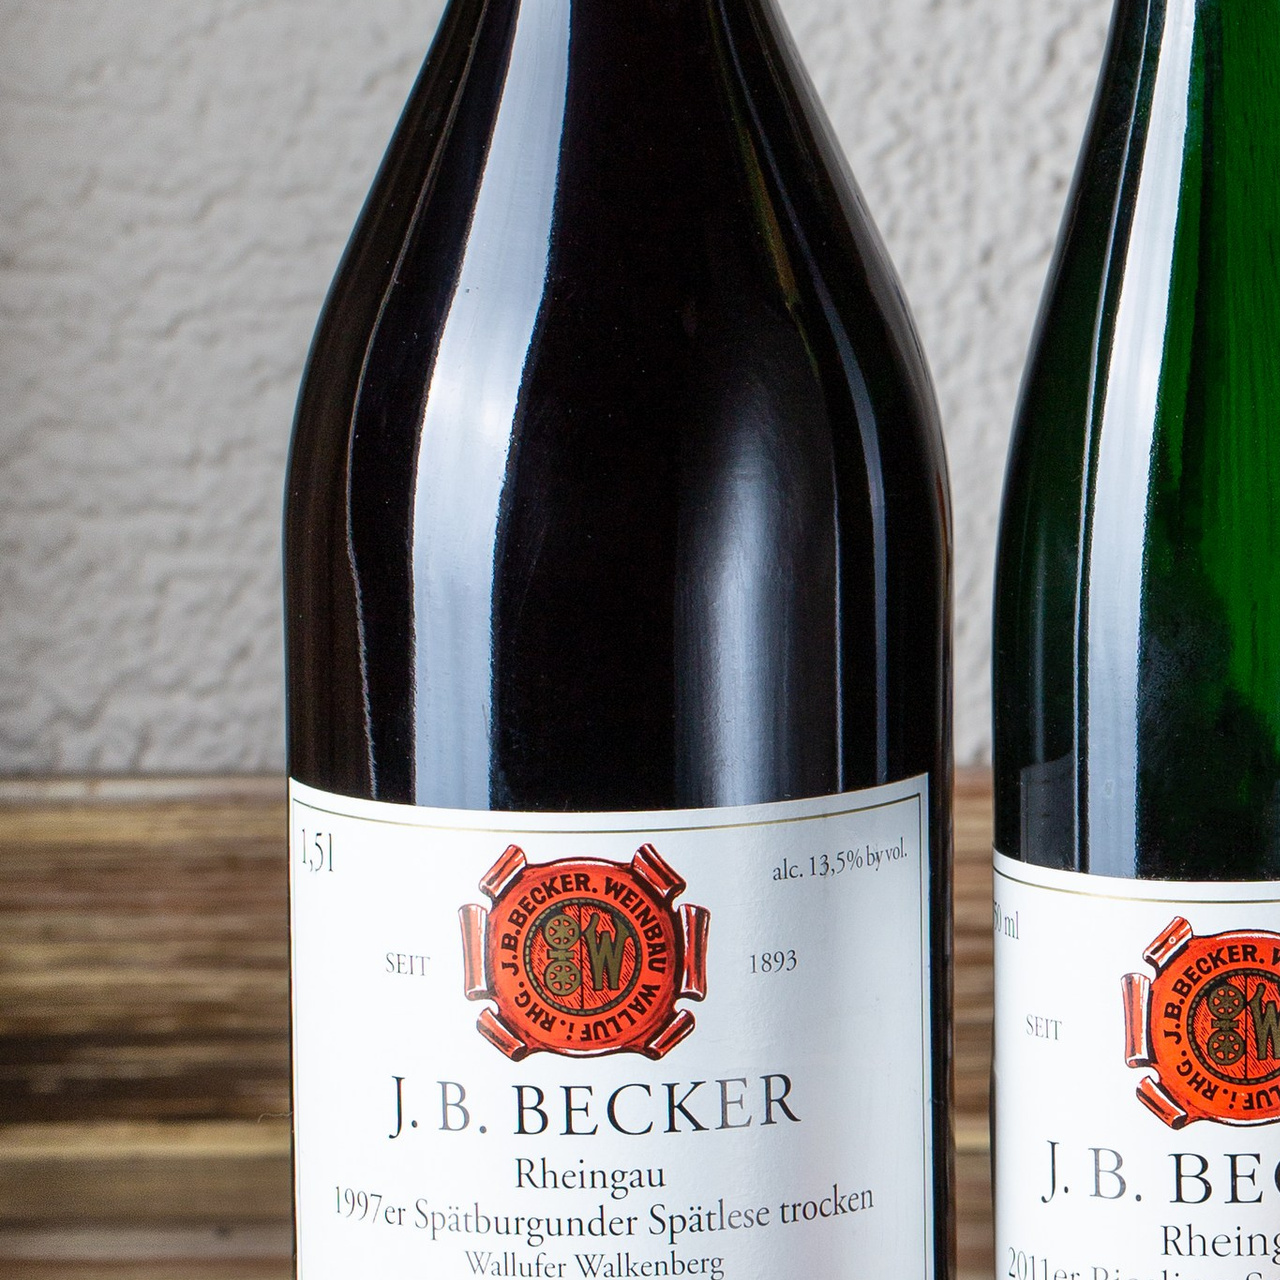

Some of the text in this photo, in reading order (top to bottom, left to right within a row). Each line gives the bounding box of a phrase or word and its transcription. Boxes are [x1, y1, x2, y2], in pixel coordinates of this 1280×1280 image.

[772, 836, 908, 881] alc. 13,5% by vol.
[604, 876, 667, 974] WEINBAU
[1003, 910, 1020, 941] ml
[385, 952, 431, 977] SEIT
[749, 949, 798, 974] 1893
[579, 982, 661, 1042] WALLUF
[1025, 1015, 1063, 1041] SEIT
[388, 1073, 802, 1140] J. B. BECKER
[515, 1156, 667, 1200] Rheingau
[1040, 1139, 1069, 1204] J.
[1087, 1147, 1143, 1203] B.
[335, 1183, 874, 1248] 1997er Spätburgunder Spätlese trocken
[464, 1250, 567, 1279] Wallufer
